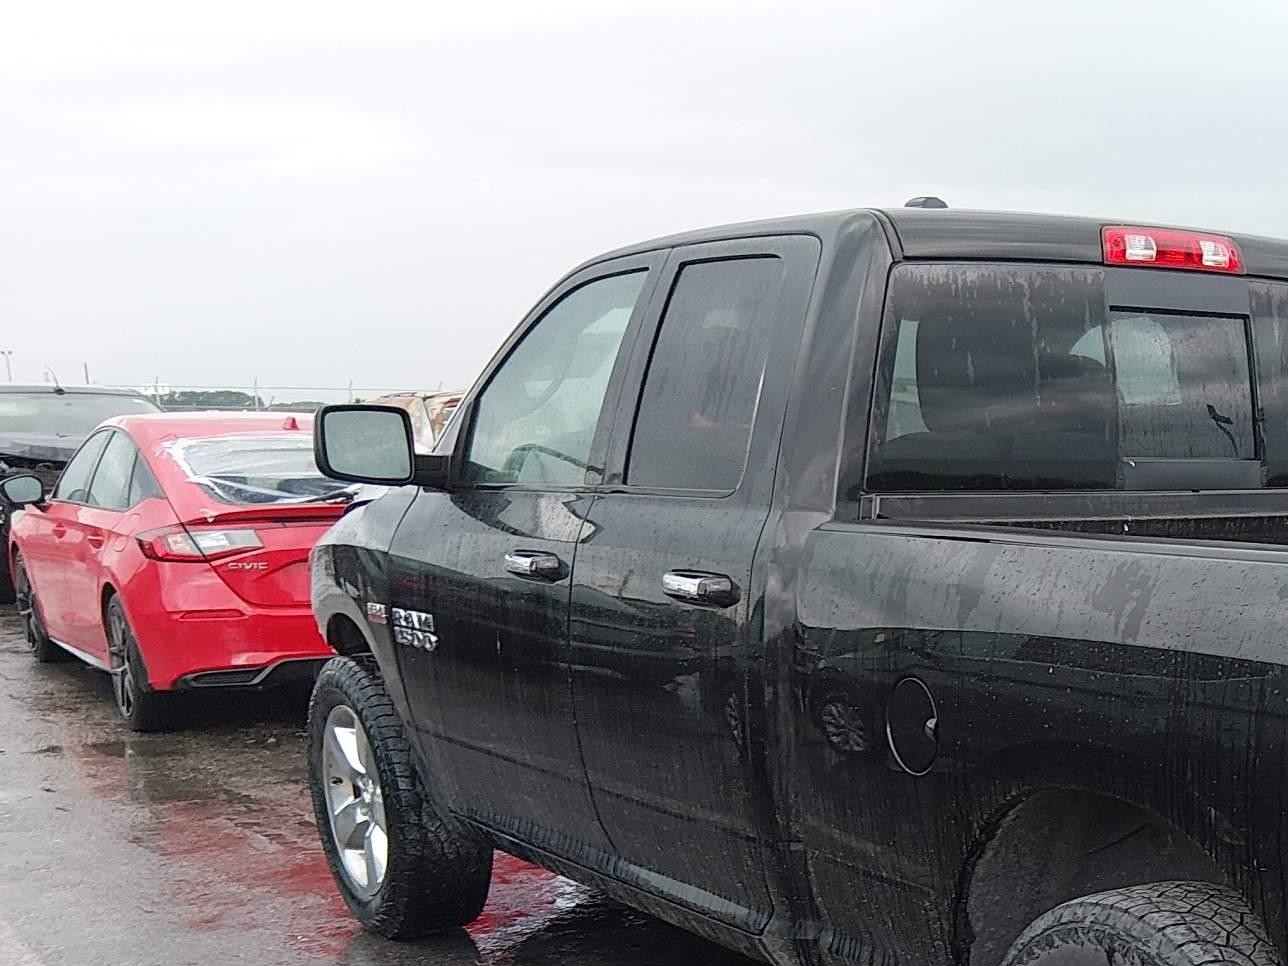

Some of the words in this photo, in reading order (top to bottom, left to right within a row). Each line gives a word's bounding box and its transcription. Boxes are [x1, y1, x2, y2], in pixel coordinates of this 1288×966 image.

[227, 562, 269, 570] CIVIC
[392, 608, 435, 632] RAM
[393, 626, 439, 651] 1500
